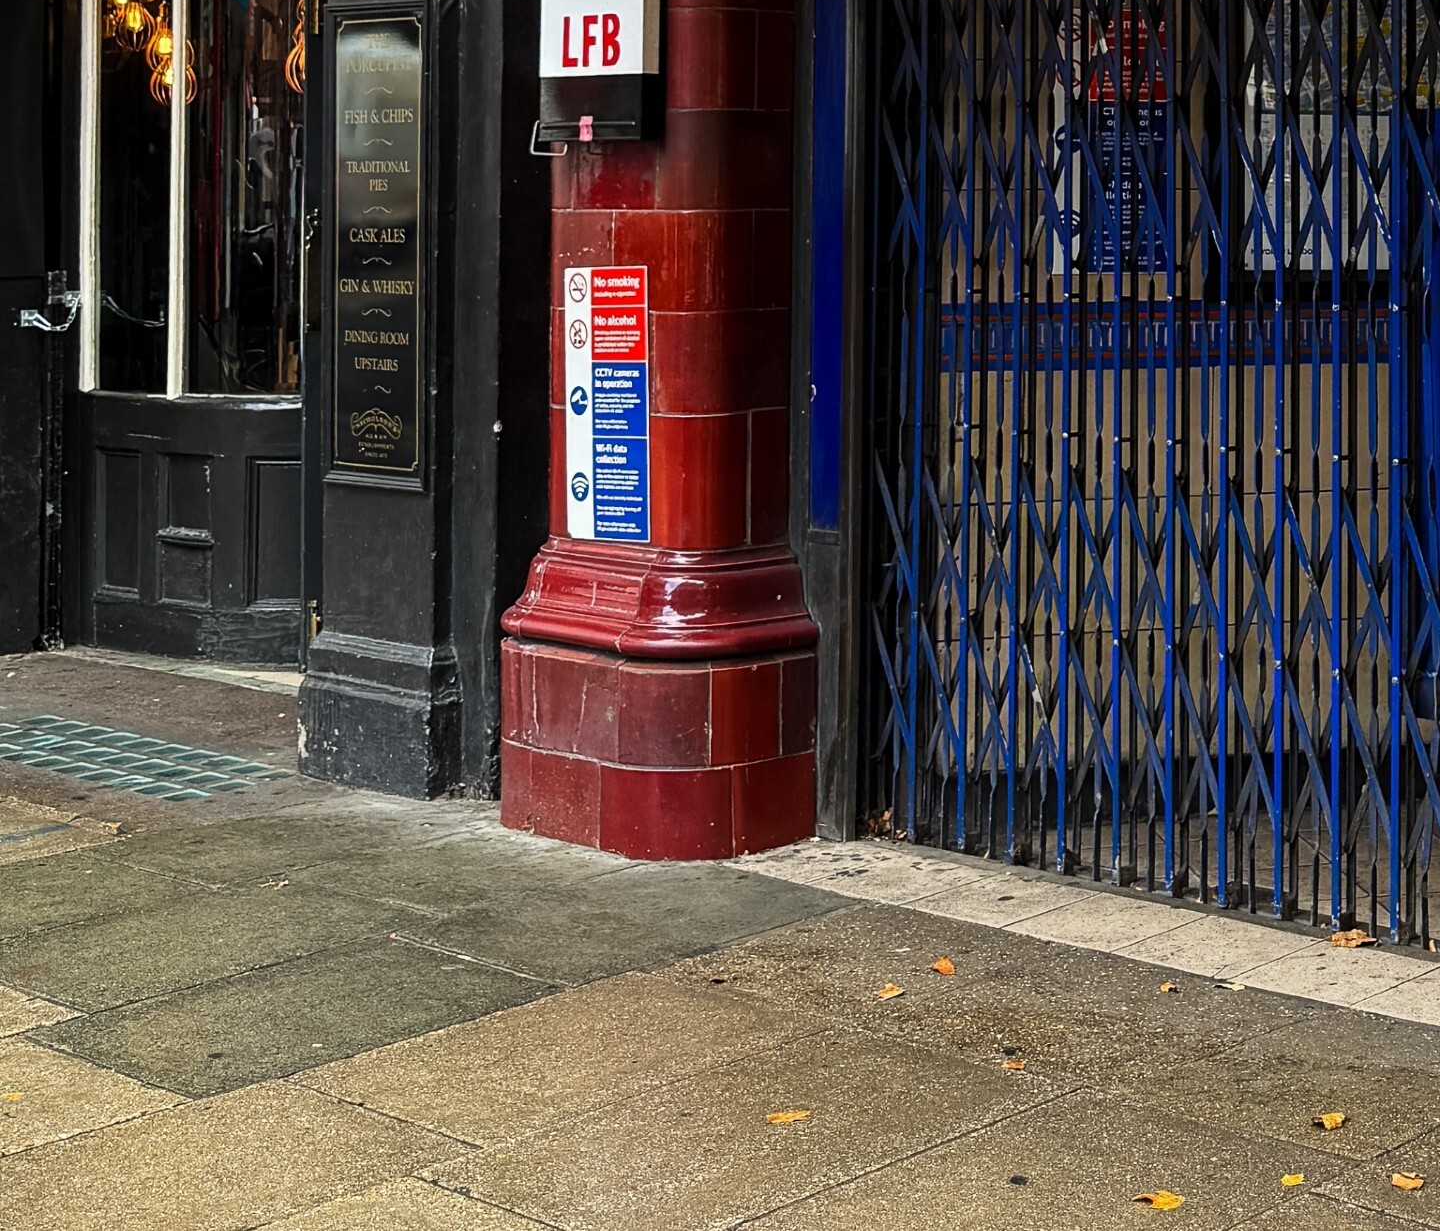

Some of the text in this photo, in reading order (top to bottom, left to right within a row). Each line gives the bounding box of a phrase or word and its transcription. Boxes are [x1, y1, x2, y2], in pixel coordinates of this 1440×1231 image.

[562, 13, 621, 68] LFB
[344, 108, 414, 124] FISH & CHIPS
[346, 161, 411, 174] TRADITIONAL
[369, 179, 389, 192] PIES
[350, 228, 406, 244] CASK ALES
[340, 278, 415, 295] GIN & WHISKY
[594, 275, 641, 289] No smoking
[594, 314, 637, 326] No alcohol
[344, 330, 410, 346] DINING ROOM
[354, 357, 399, 372] UPSTAIRS
[595, 367, 640, 378] CCTV cameras
[602, 379, 633, 389] operation
[613, 444, 628, 453] data
[595, 454, 627, 464] collection
